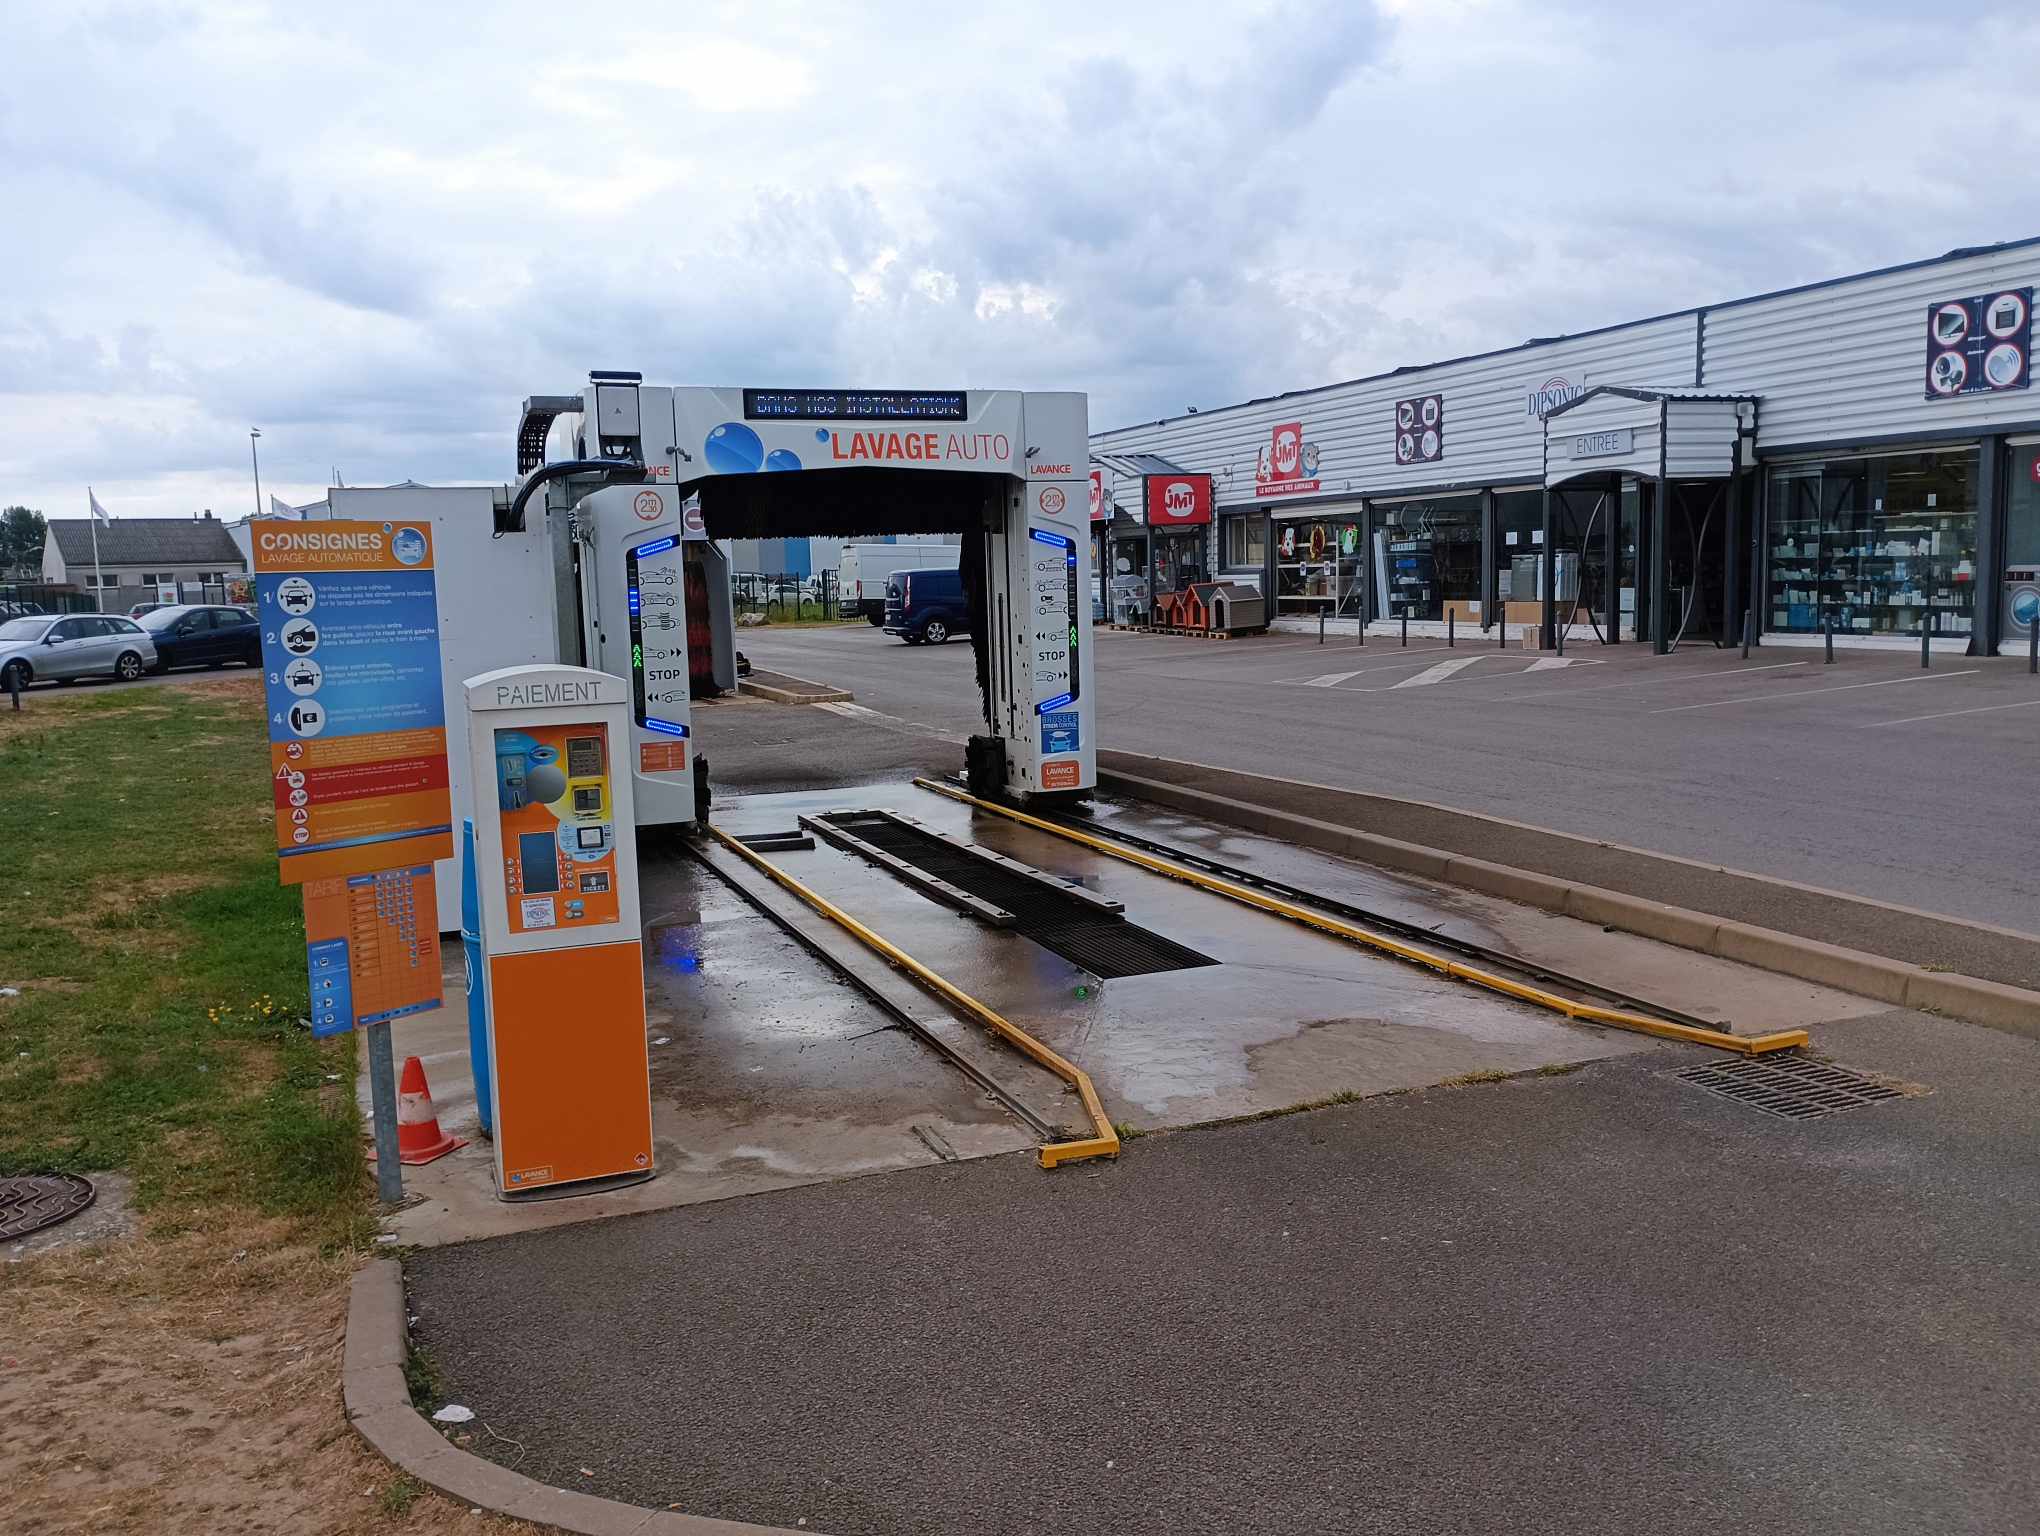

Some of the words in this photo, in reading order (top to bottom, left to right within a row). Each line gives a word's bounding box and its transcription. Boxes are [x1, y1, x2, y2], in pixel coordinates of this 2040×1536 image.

[832, 432, 940, 459] LAVAGE
[946, 434, 1009, 460] AUTO
[1577, 433, 1618, 454] ENTREE
[1031, 464, 1072, 474] LAVANCE
[260, 533, 383, 550] CONSIGNES
[261, 552, 305, 563] LAVAGE
[307, 551, 384, 562] AUTOMATIQUE
[1038, 651, 1066, 661] STOP
[649, 669, 681, 681] STOP
[497, 681, 603, 705] PAIEMENT
[1046, 766, 1075, 776] LAVANCE
